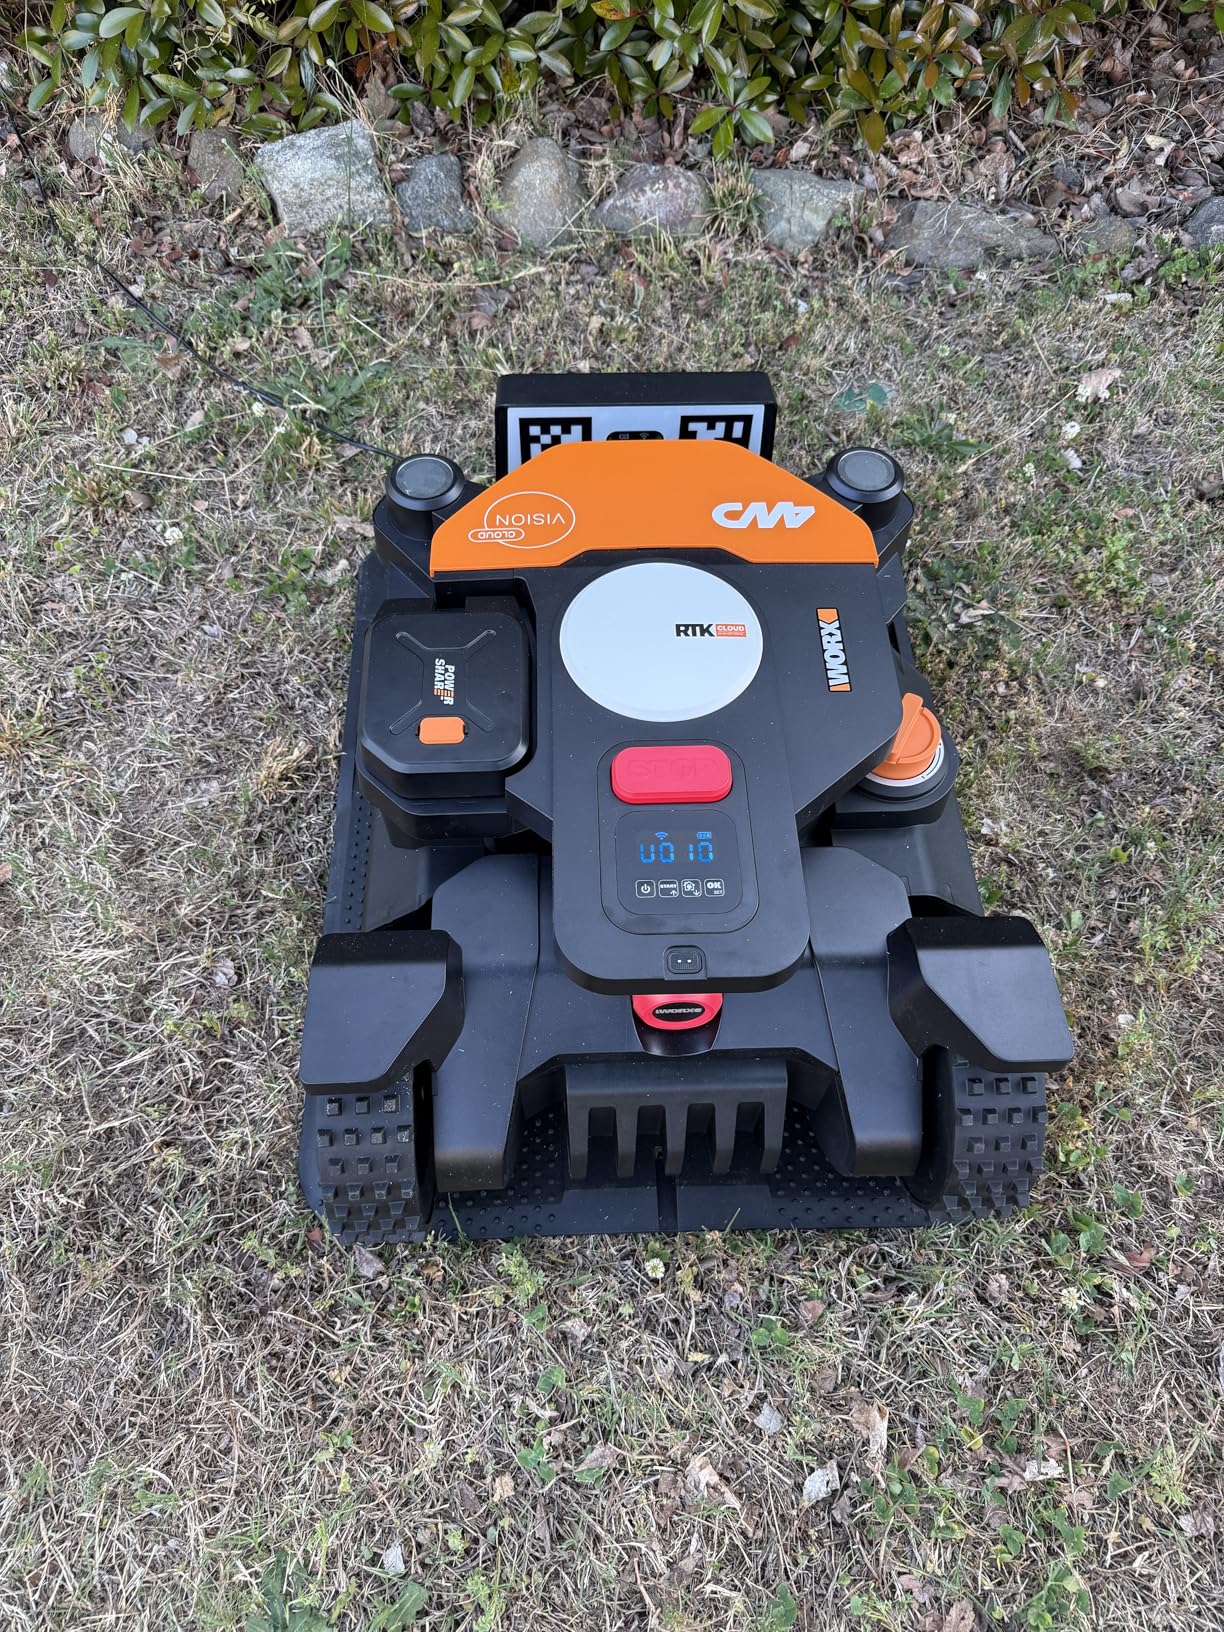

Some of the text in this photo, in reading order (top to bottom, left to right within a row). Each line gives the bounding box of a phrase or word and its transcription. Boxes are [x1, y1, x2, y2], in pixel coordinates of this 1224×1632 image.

[495, 512, 565, 526] VISION
[711, 501, 816, 529] 4WD
[477, 530, 516, 540] CLOUD
[675, 623, 715, 637] RTK
[819, 620, 849, 686] WORX
[433, 658, 446, 696] SHARE
[443, 664, 456, 706] POWER
[706, 881, 722, 889] OK
